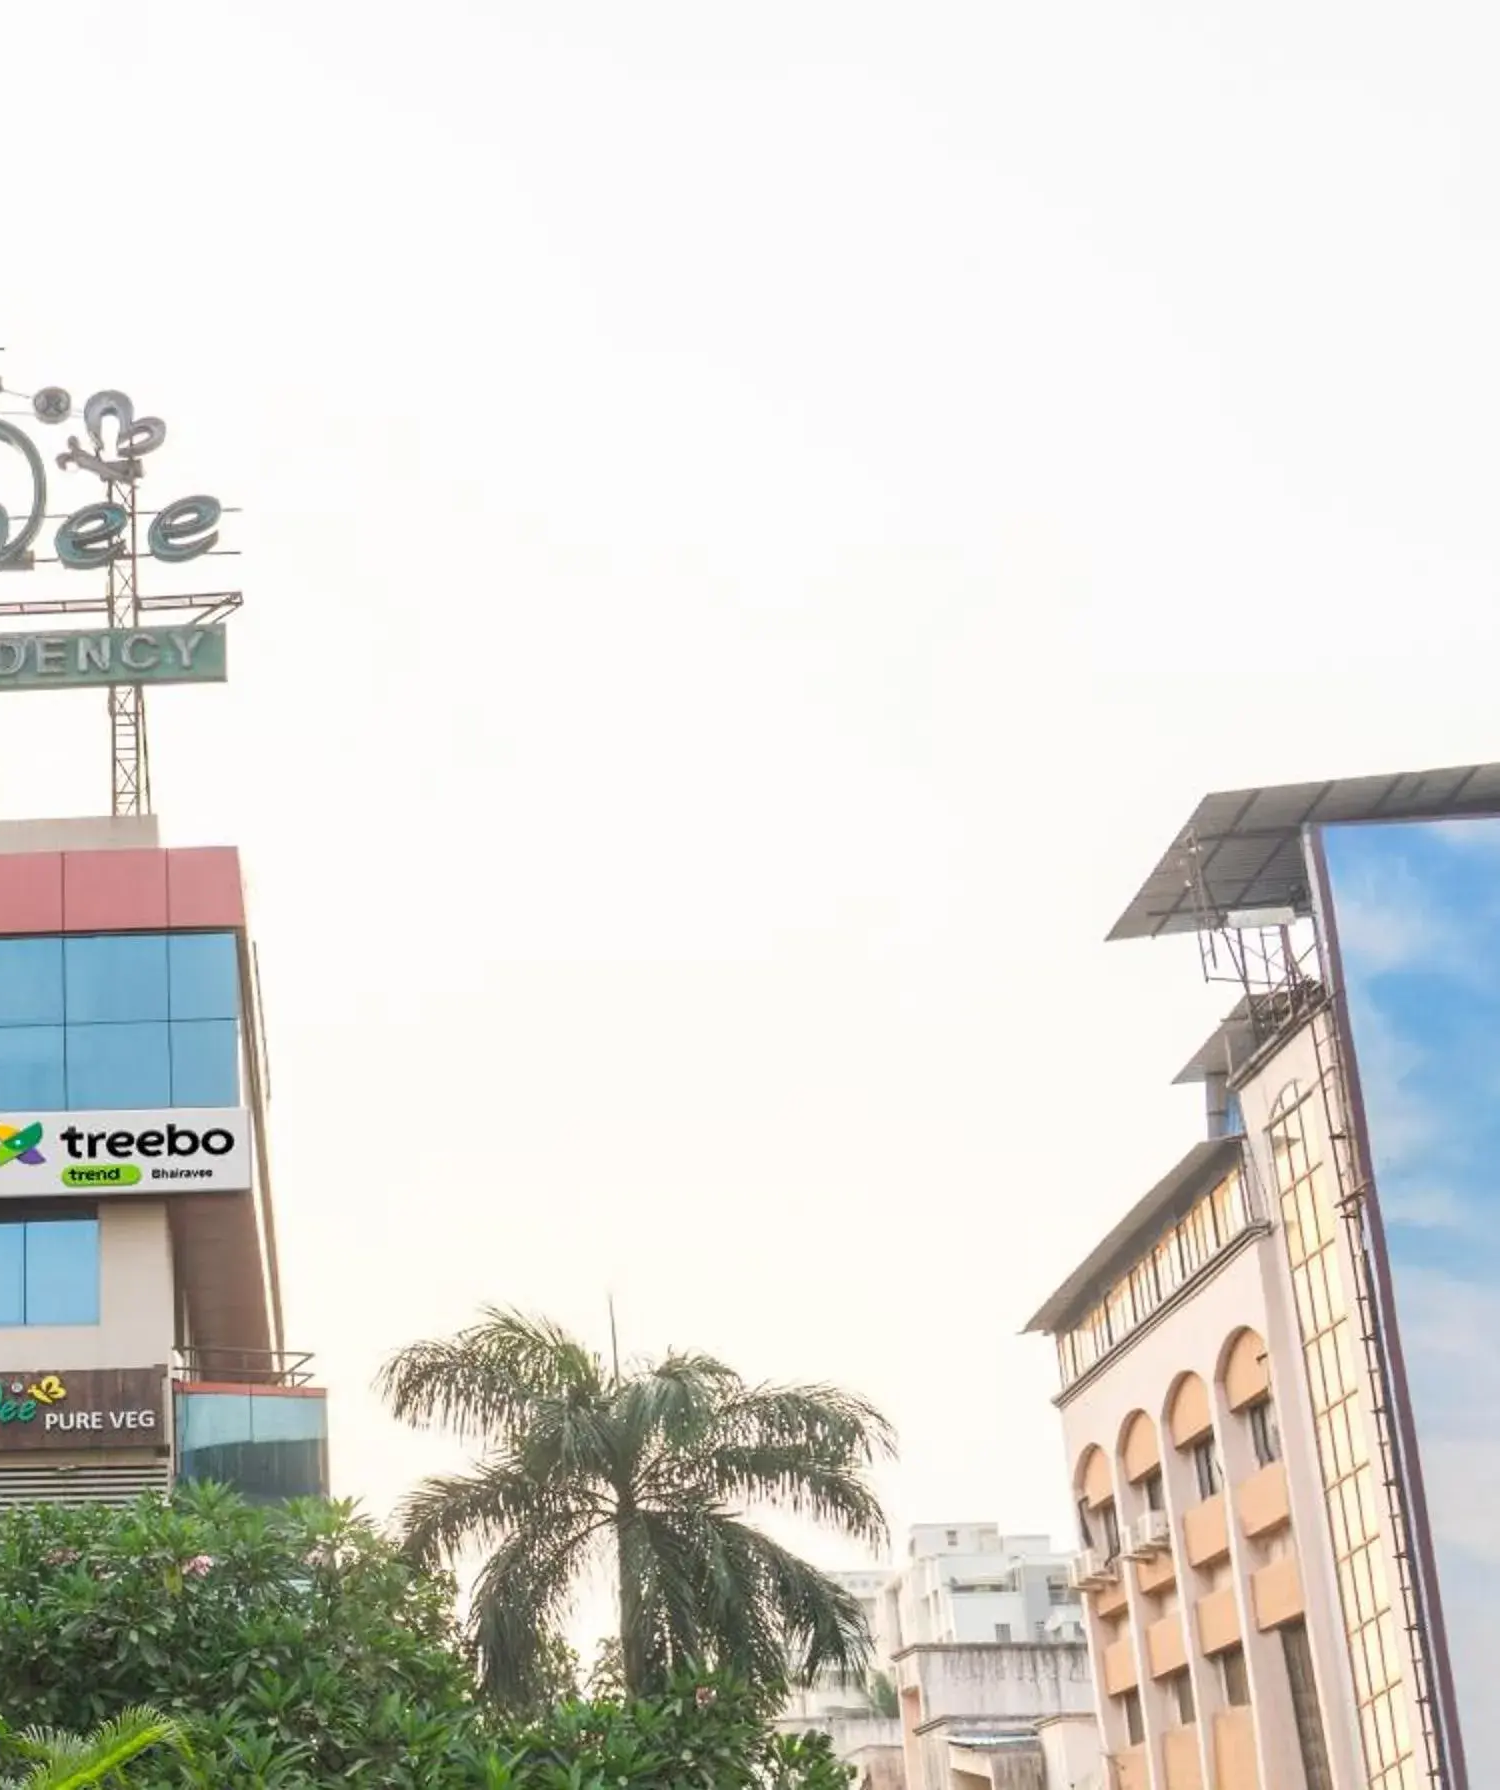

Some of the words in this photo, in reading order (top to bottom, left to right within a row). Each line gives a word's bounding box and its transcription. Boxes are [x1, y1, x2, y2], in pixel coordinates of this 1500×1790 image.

[60, 1124, 235, 1158] treebo
[67, 1168, 121, 1181] trend
[151, 1169, 213, 1181] Bhairavee
[45, 1411, 103, 1431] PURE
[110, 1409, 156, 1430] VEG
